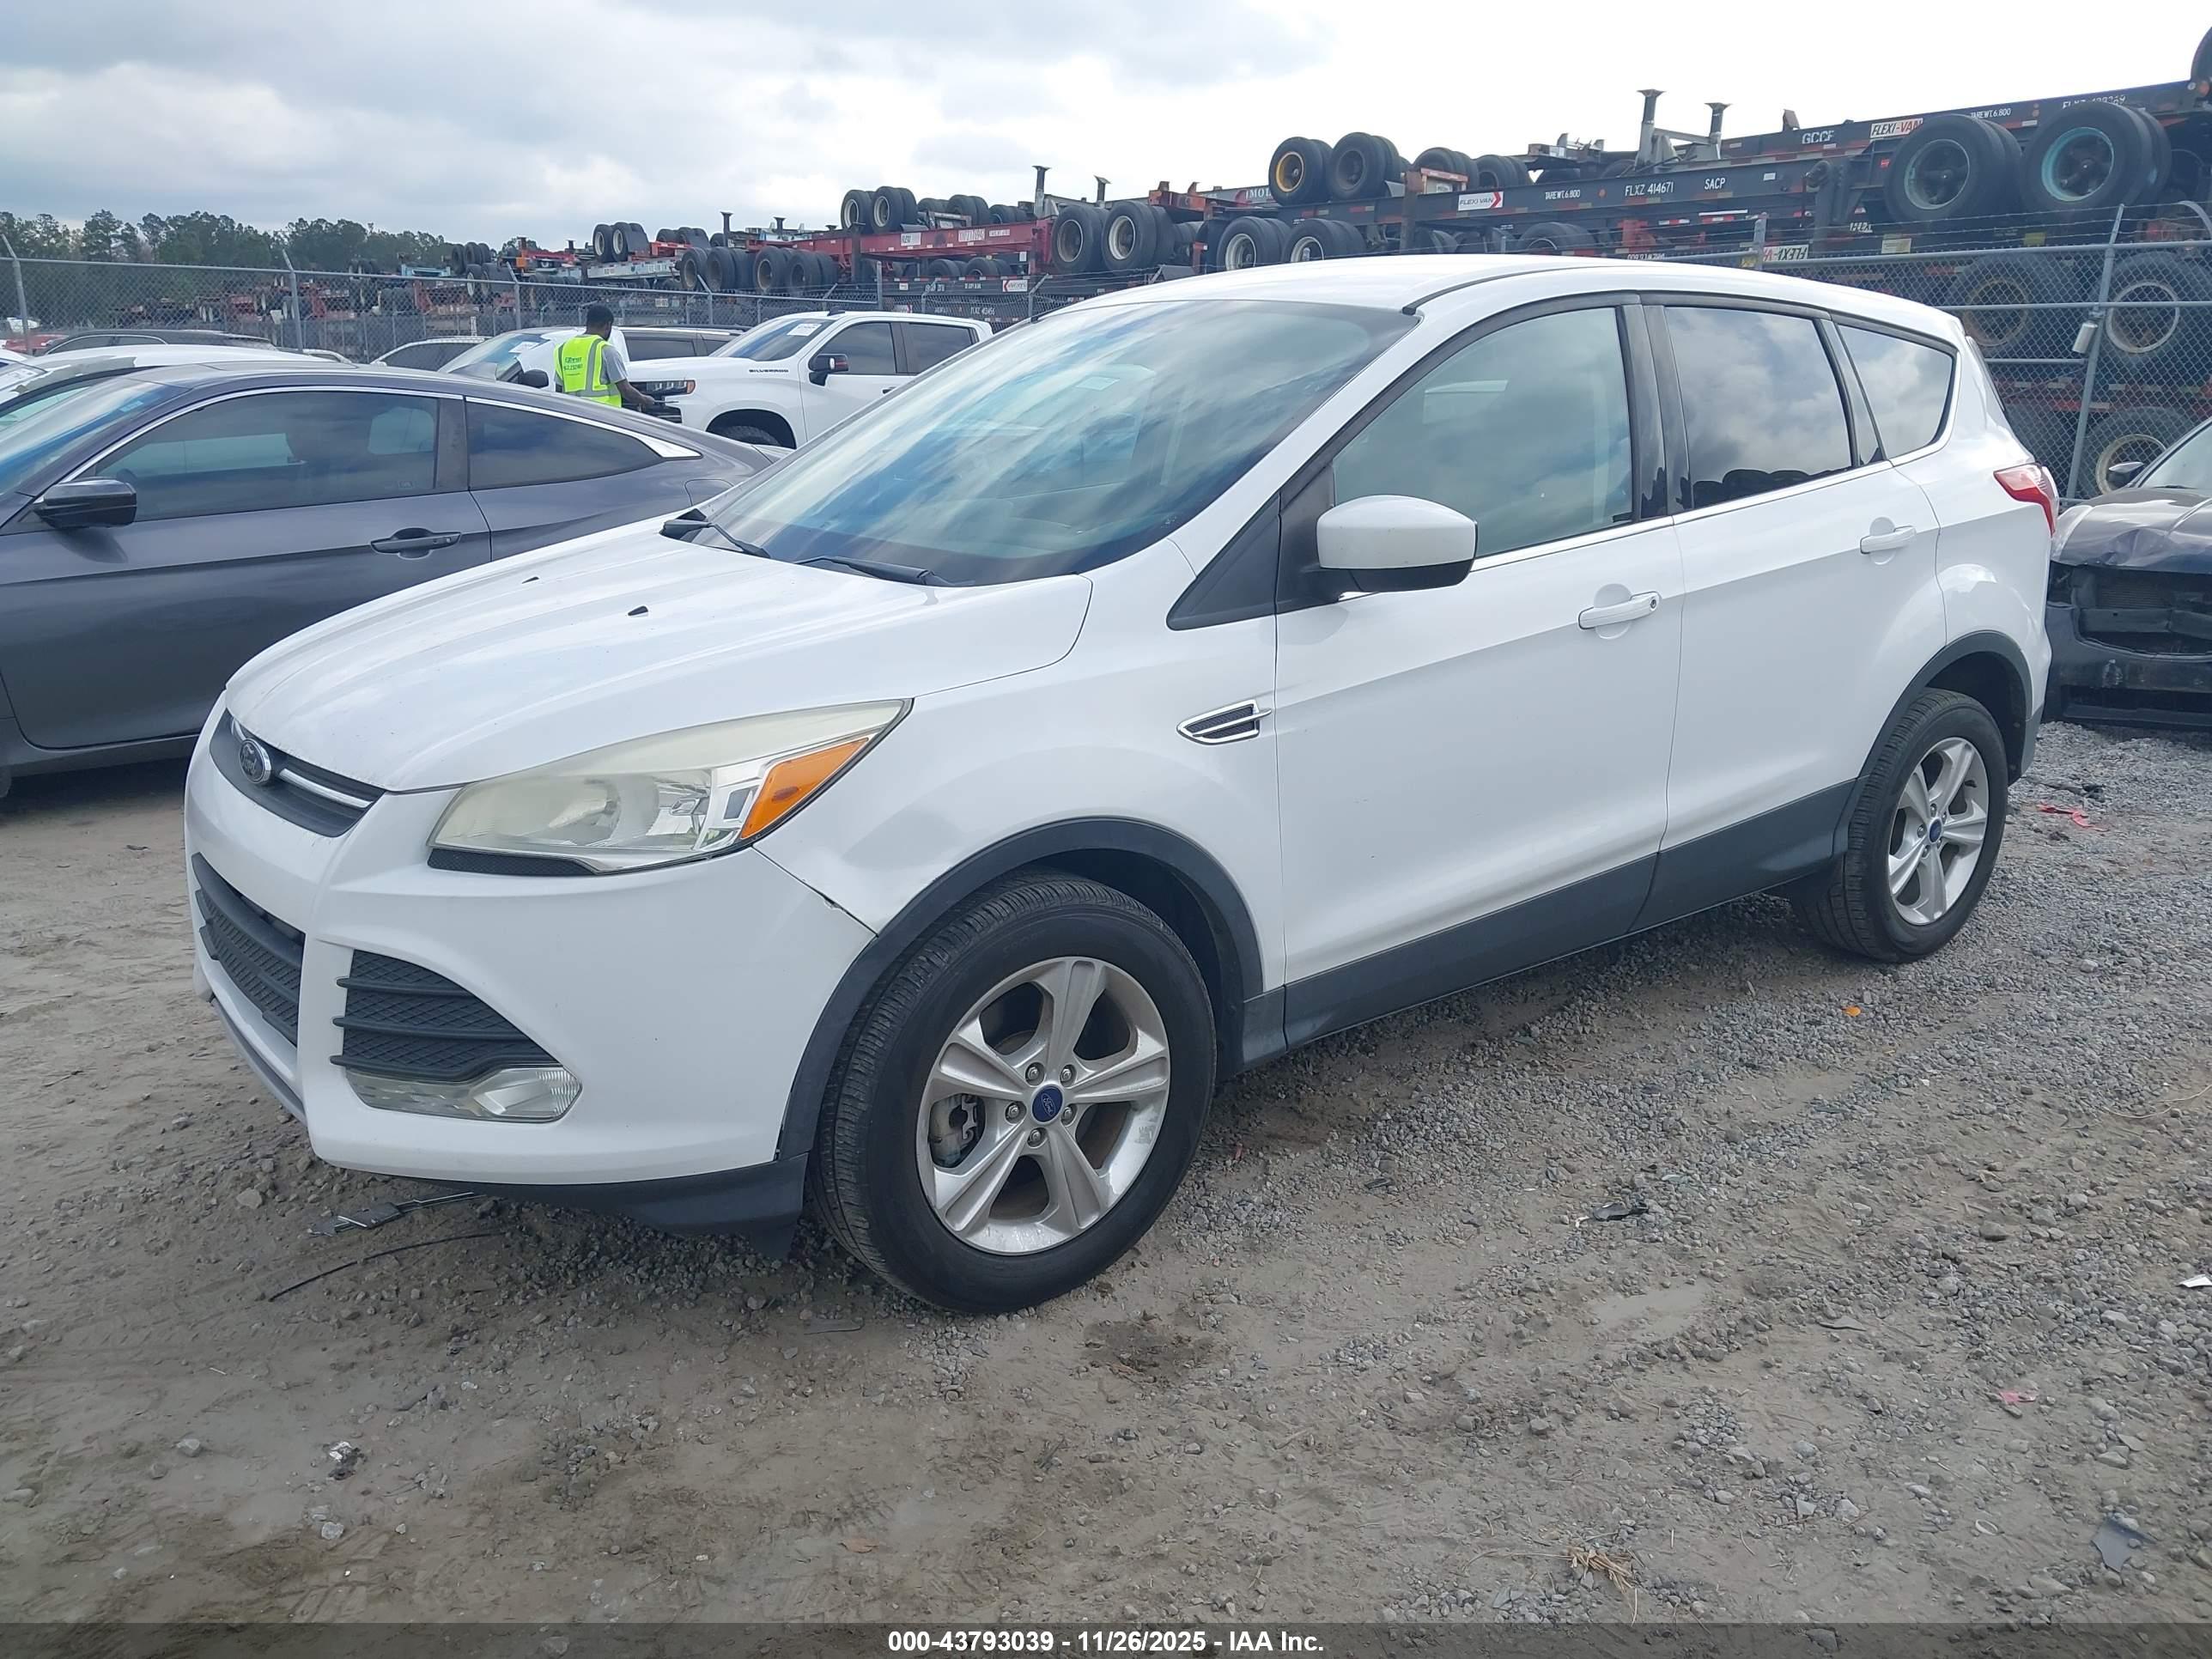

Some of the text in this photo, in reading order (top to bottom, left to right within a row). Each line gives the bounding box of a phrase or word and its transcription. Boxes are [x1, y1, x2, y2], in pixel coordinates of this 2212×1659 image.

[1625, 181, 1674, 197] FLXZ 414671
[1704, 177, 1726, 190] SACP
